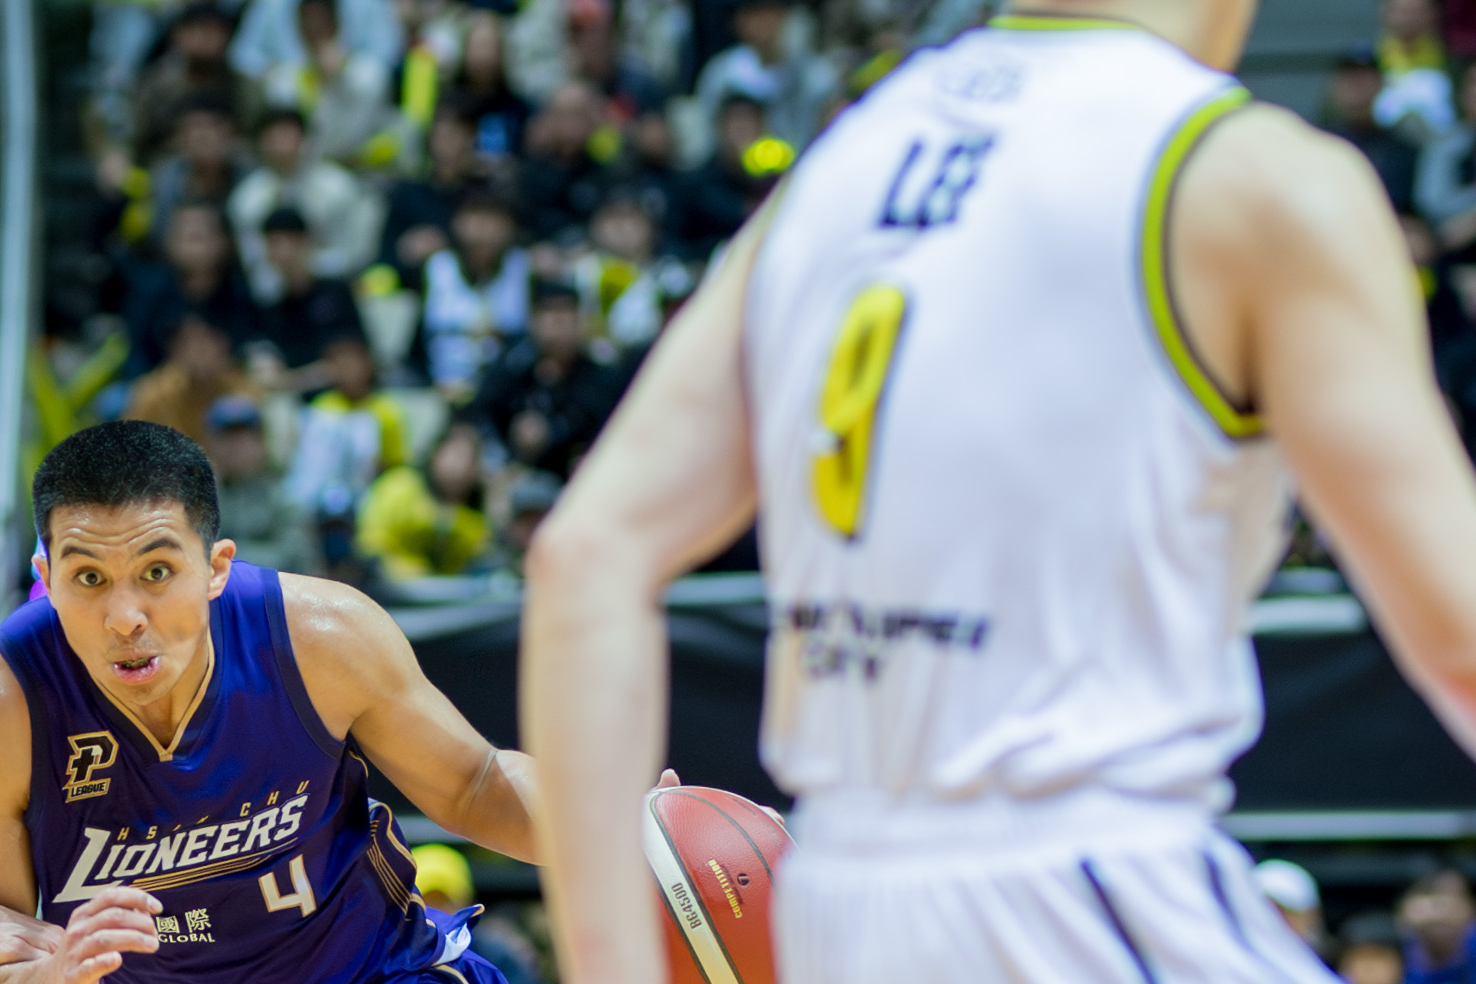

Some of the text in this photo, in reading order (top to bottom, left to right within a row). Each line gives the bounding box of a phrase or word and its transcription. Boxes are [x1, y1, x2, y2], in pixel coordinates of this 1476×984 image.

[811, 284, 907, 542] 9
[71, 782, 106, 797] LEAGUE
[52, 794, 309, 903] LIONEERS
[258, 854, 317, 918] 4
[671, 882, 702, 929] BG4500
[708, 859, 742, 918] COMPETITION
[156, 908, 212, 933] 國際
[158, 933, 216, 943] GLOBAL
